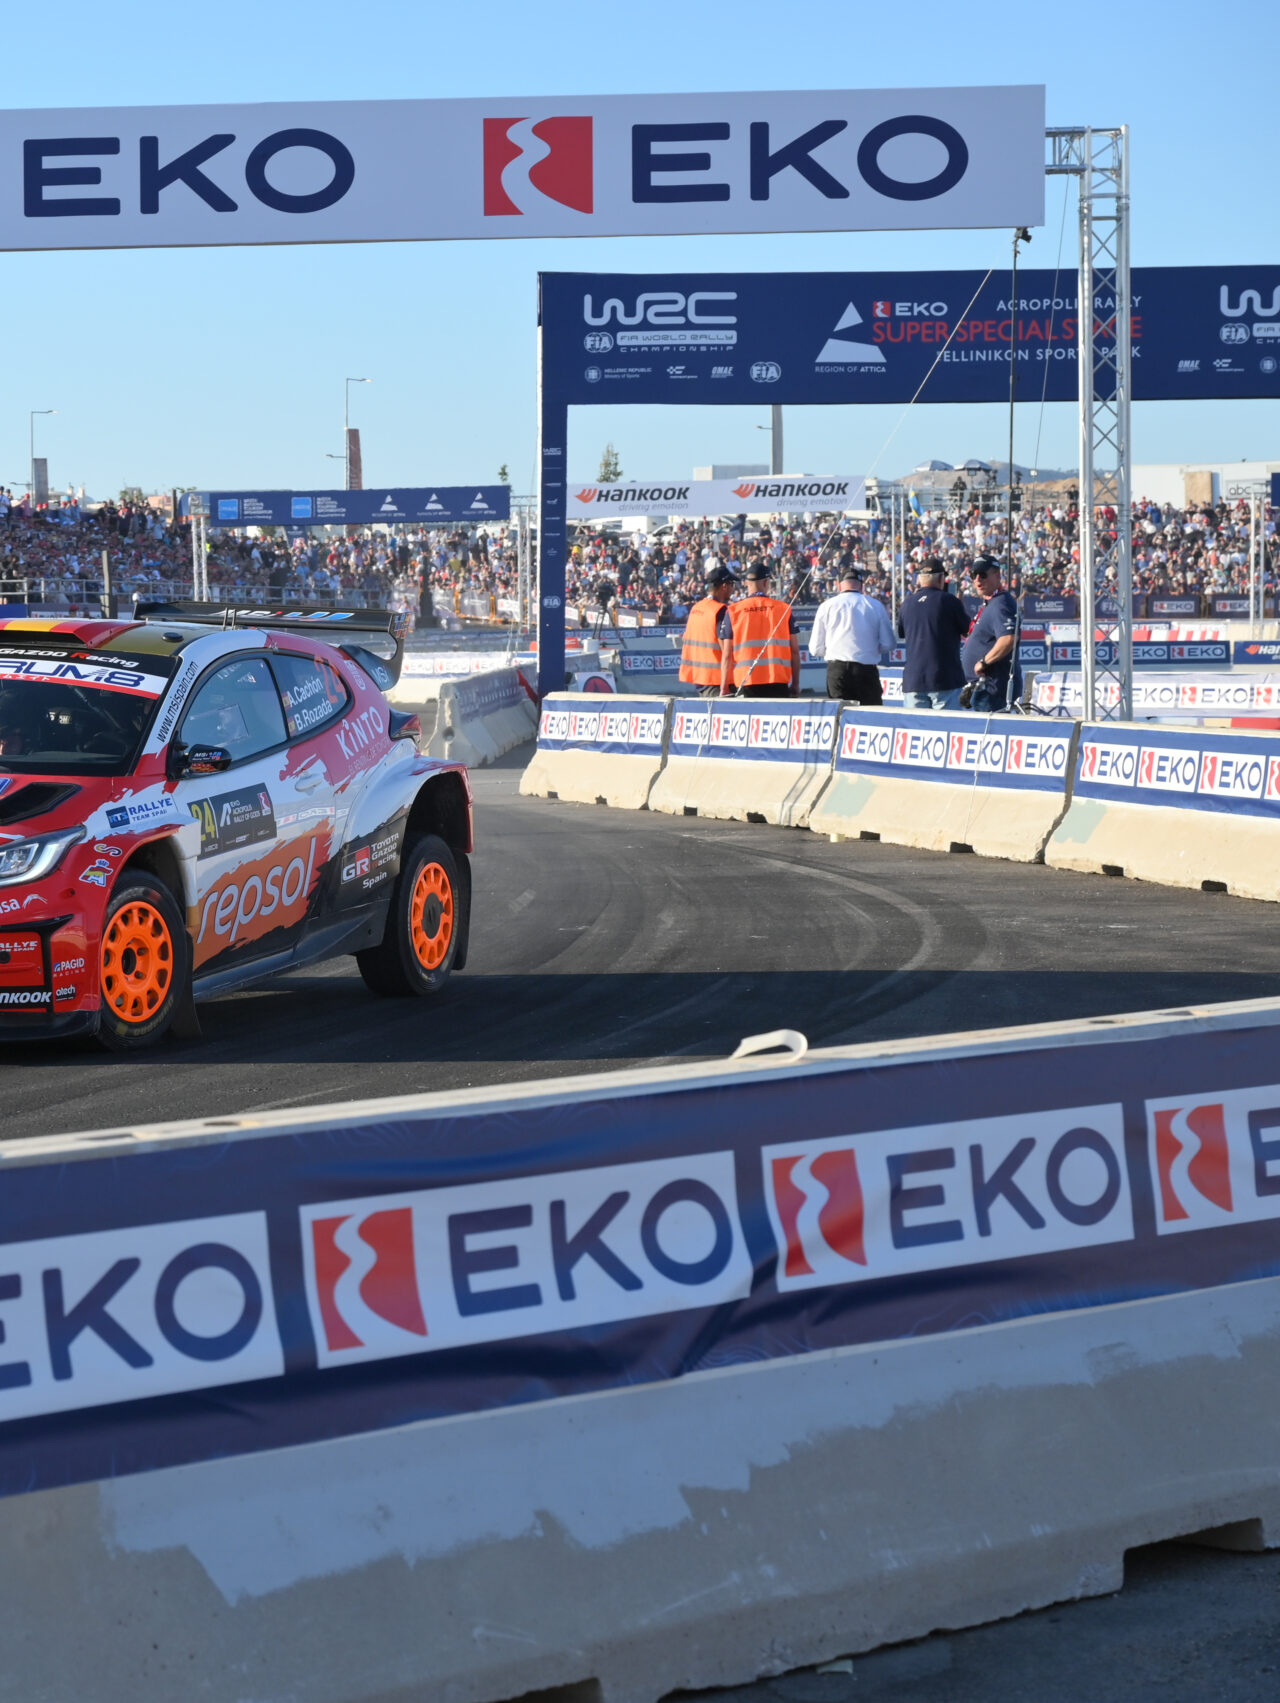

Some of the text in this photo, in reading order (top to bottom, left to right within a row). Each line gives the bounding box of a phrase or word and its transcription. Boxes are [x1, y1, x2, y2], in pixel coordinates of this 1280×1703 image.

[23, 114, 969, 217] EKO EKO
[584, 291, 737, 326] WRC
[895, 302, 948, 317] EKO
[996, 298, 1078, 312] ACROPOLI
[872, 318, 1058, 343] SUPER SPECIAL
[1221, 324, 1249, 343] FIA
[943, 349, 1029, 363] ELLINIKON
[1101, 346, 1141, 358] PAK
[752, 363, 779, 380] FIA
[860, 365, 886, 373] ATTICA
[1167, 601, 1194, 611] EKO
[70, 652, 140, 668] Racing
[1021, 648, 1043, 658] KO
[1188, 647, 1224, 657] EKO
[632, 656, 653, 668] EKO
[157, 660, 199, 743] www.msispain.com
[1201, 687, 1248, 704] EKO
[296, 698, 333, 732] B.Rozada
[549, 712, 662, 741] EKO EKO EKO EKO
[685, 715, 832, 745] EKO EKO EKO EKO
[858, 730, 1065, 771] EKO EKO EKO EKO
[1097, 749, 1262, 792] EKO EKO EKO
[129, 798, 173, 816] RALLYE
[232, 804, 253, 816] ACROPOLIS
[132, 813, 150, 822] TEAM
[191, 801, 216, 841] 24
[234, 813, 245, 823] RALLY
[371, 832, 400, 851] TOYOTA
[371, 842, 398, 860] GAZOO
[342, 857, 369, 881] GR
[362, 870, 388, 889] Spain
[196, 836, 316, 945] repsol
[60, 957, 85, 971] PAGID
[886, 1126, 1123, 1250] EKO
[447, 1177, 734, 1319] EKO
